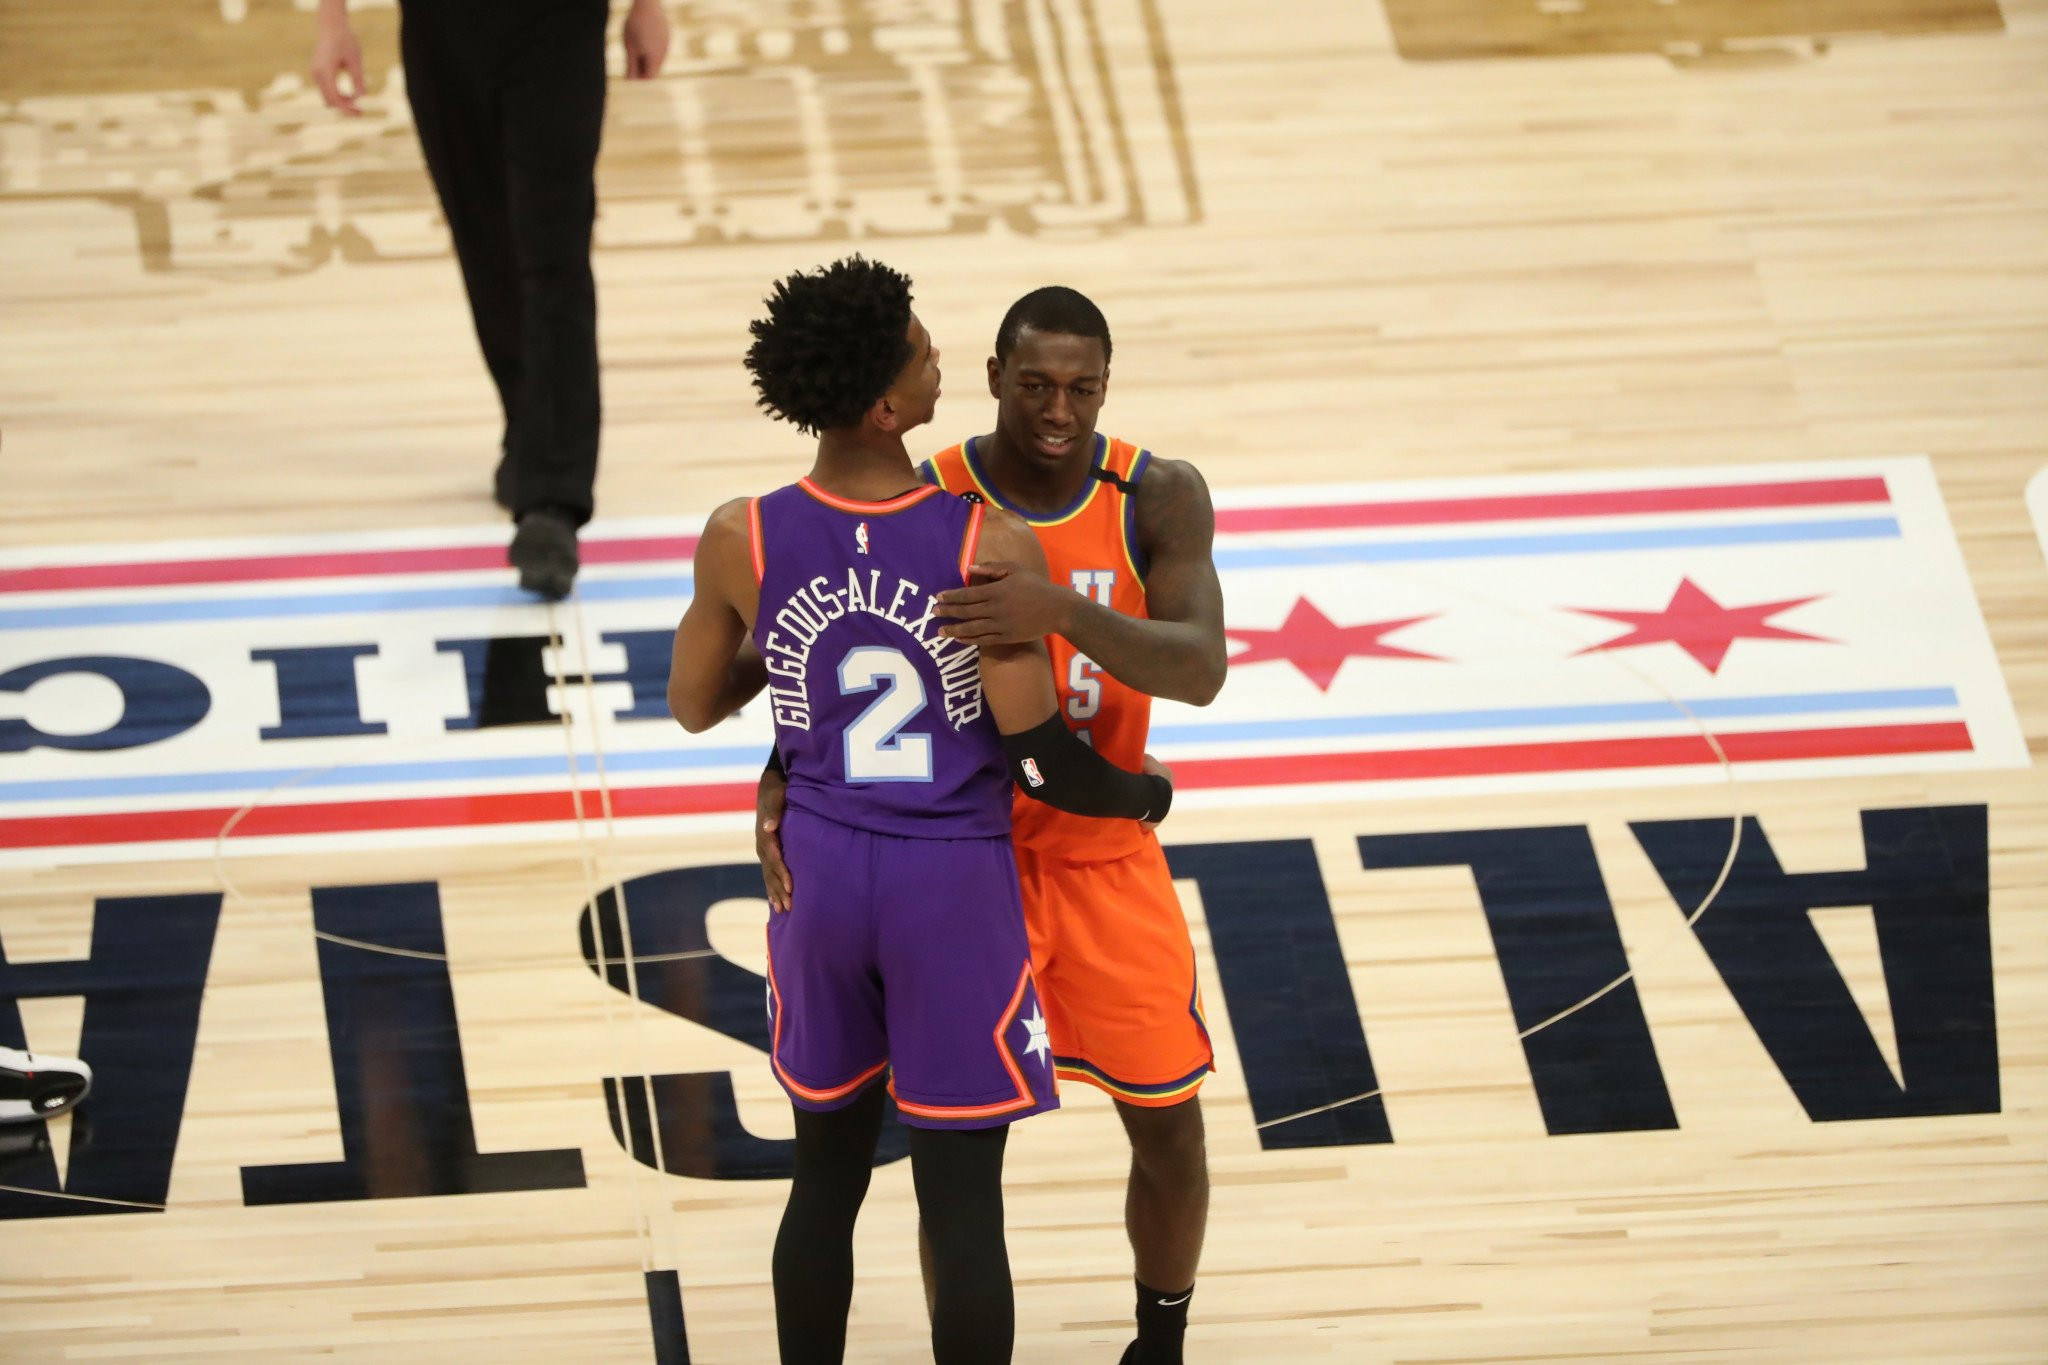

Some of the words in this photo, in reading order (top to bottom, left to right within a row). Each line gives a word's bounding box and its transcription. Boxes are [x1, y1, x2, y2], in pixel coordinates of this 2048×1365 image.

[0, 628, 740, 754] HIC
[766, 567, 982, 732] GILGEOUS-ALEXANDER
[837, 645, 934, 784] 2
